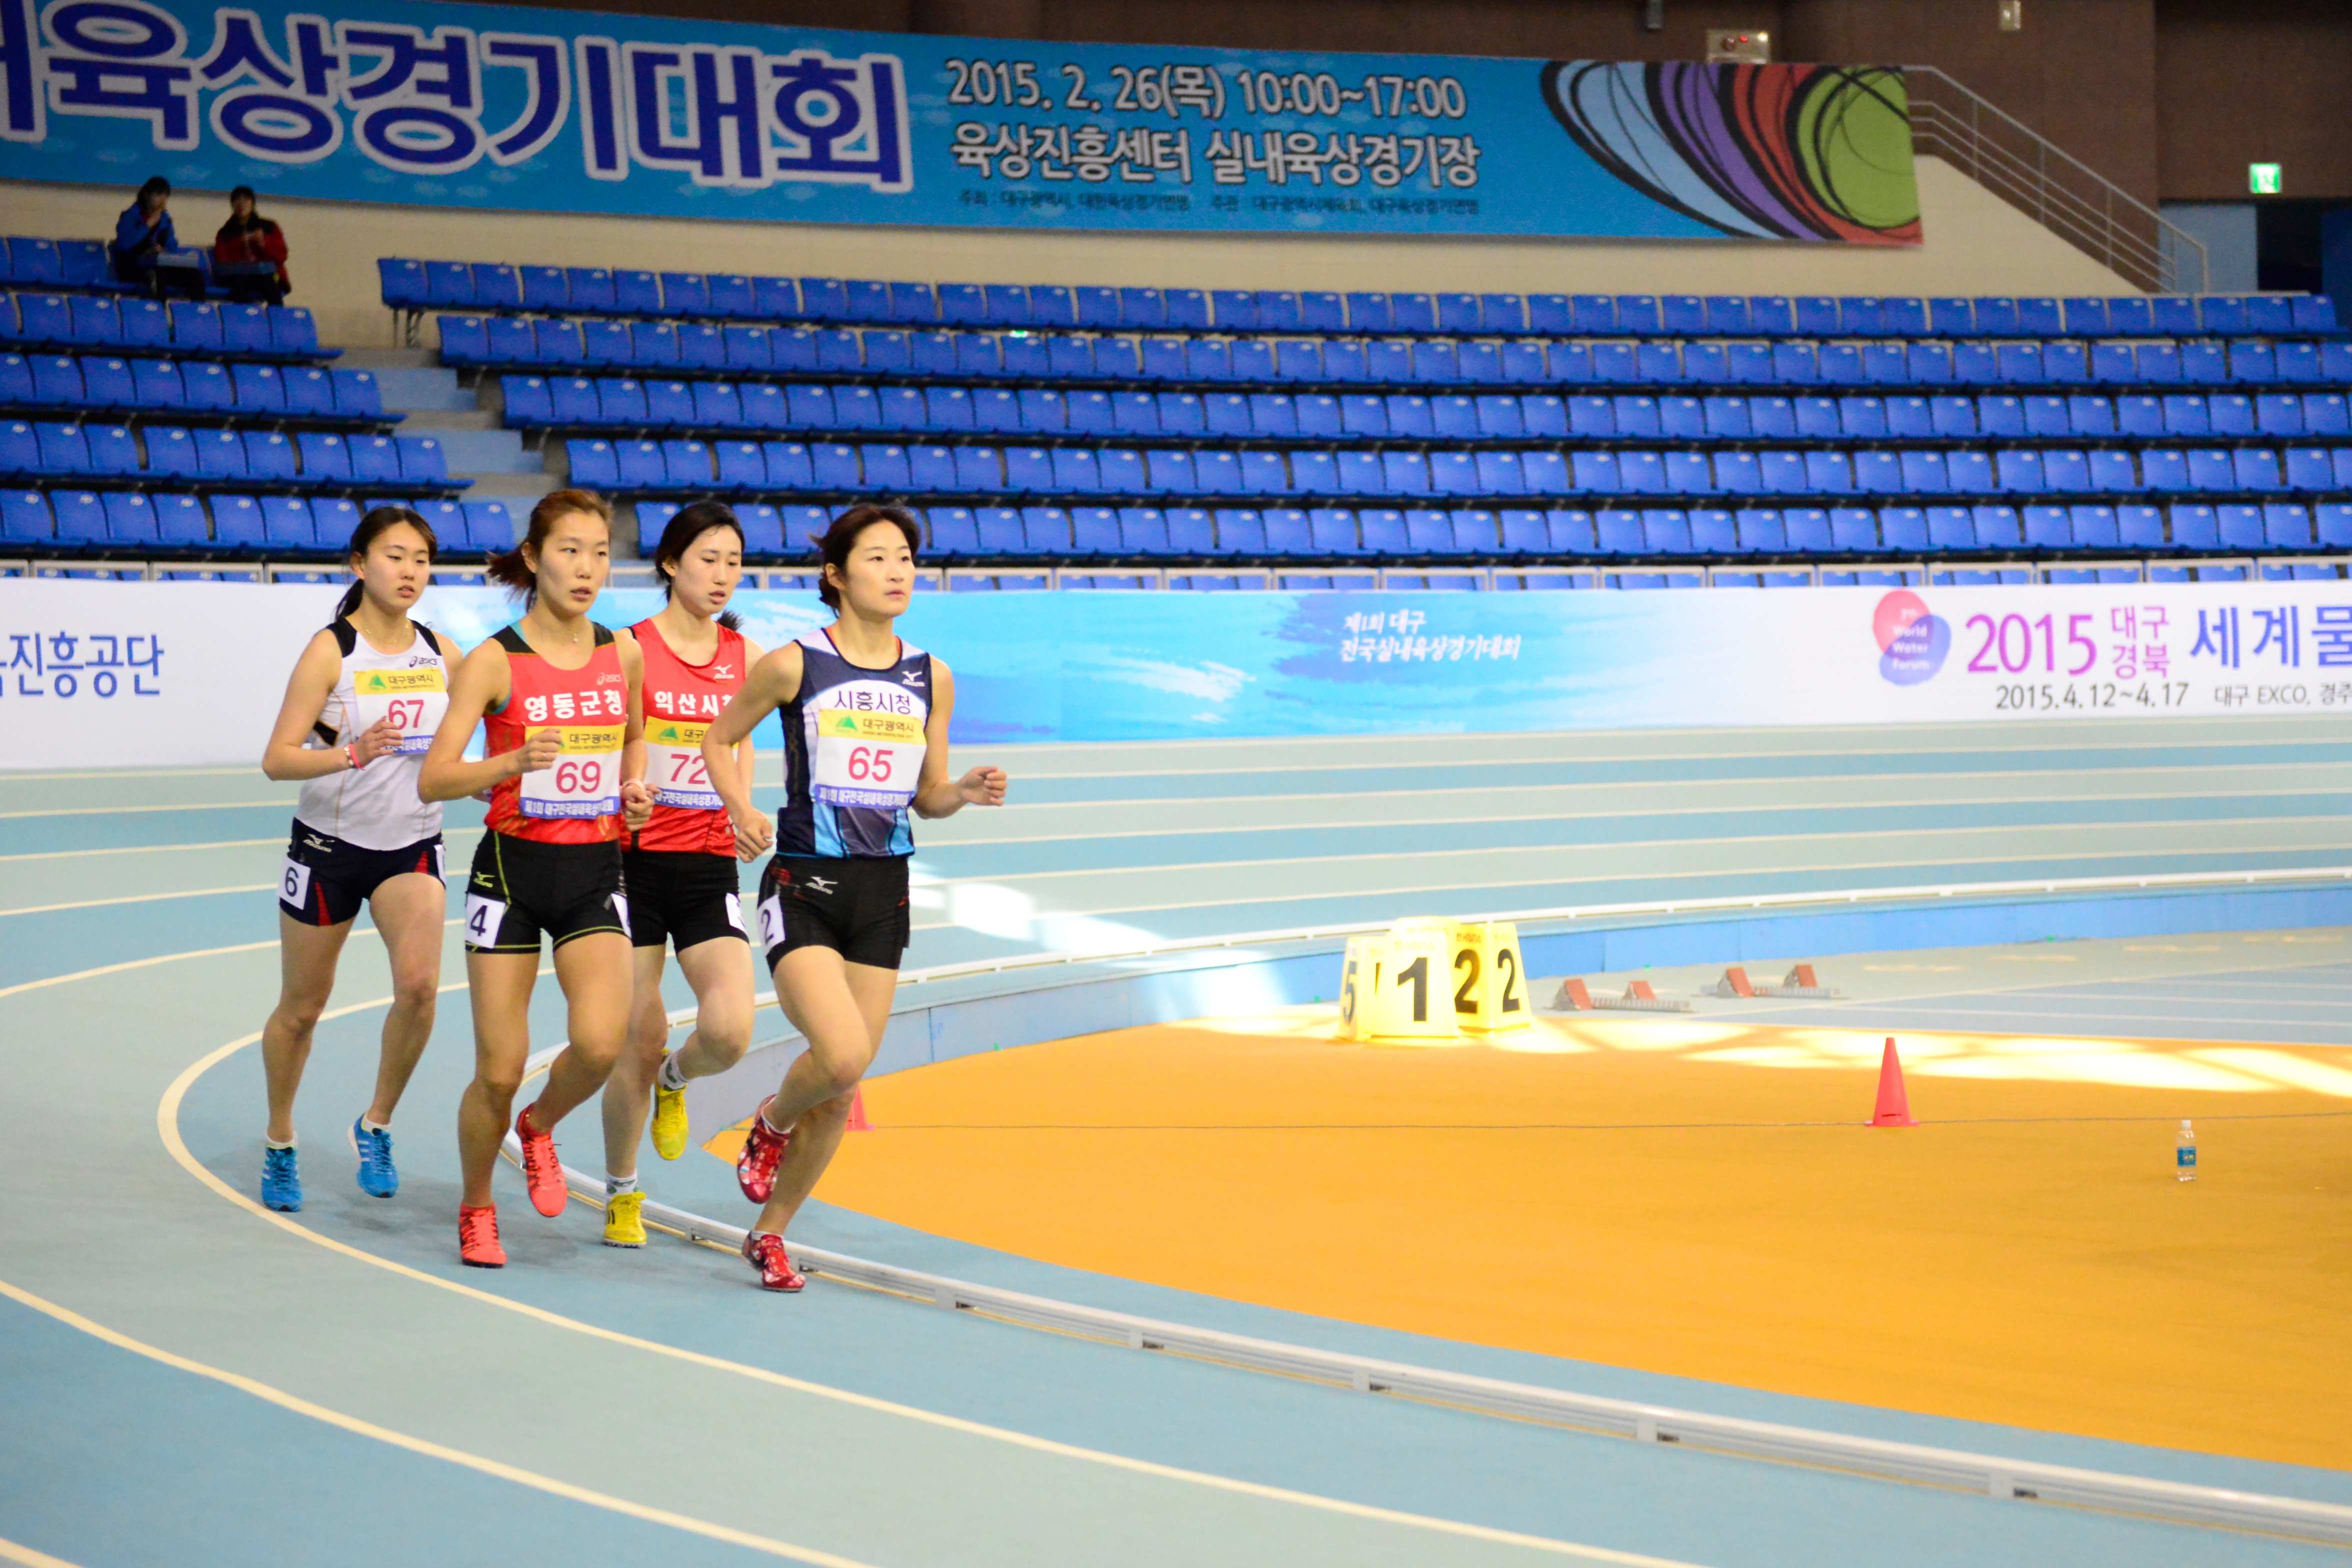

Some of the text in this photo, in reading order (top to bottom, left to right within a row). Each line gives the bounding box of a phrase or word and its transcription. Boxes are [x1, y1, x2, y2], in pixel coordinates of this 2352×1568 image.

[0, 0, 912, 192] 육상경기대회
[946, 59, 1467, 119] 2015. 2. 26(목) 10:00~17:00
[951, 121, 1482, 188] 육상진흥센터 실내육상경기장
[1343, 608, 1426, 634] 제1회 대구
[1893, 625, 1928, 637] World
[2111, 606, 2170, 640] 대구
[2190, 605, 2352, 669] 세계물
[1340, 634, 1521, 662] 전국실내육상경기대회
[1893, 642, 1928, 654] Water
[1966, 613, 2098, 675] 2015
[0, 631, 164, 698] 진흥공단
[2112, 644, 2170, 679] 경북
[388, 674, 434, 684] 대구광역시
[2214, 684, 2250, 706] 대구
[2258, 684, 2311, 706] EXCO,
[524, 689, 623, 721] 영동군청
[834, 691, 911, 715] 시흥시청
[1996, 682, 2190, 710] 2015.4.12~4.17
[388, 699, 424, 730] 67
[863, 719, 914, 733] 대구광역시
[570, 733, 618, 744] 대구광역시
[556, 761, 601, 794] 69
[670, 754, 707, 785] 72
[848, 747, 894, 782] 65
[284, 866, 299, 897] 6
[470, 905, 488, 937] 4
[761, 909, 774, 945] 2
[1343, 961, 1358, 1026] 5
[1398, 957, 1428, 1022] 1
[1454, 949, 1481, 1014] 2
[1498, 949, 1521, 1013] 2
